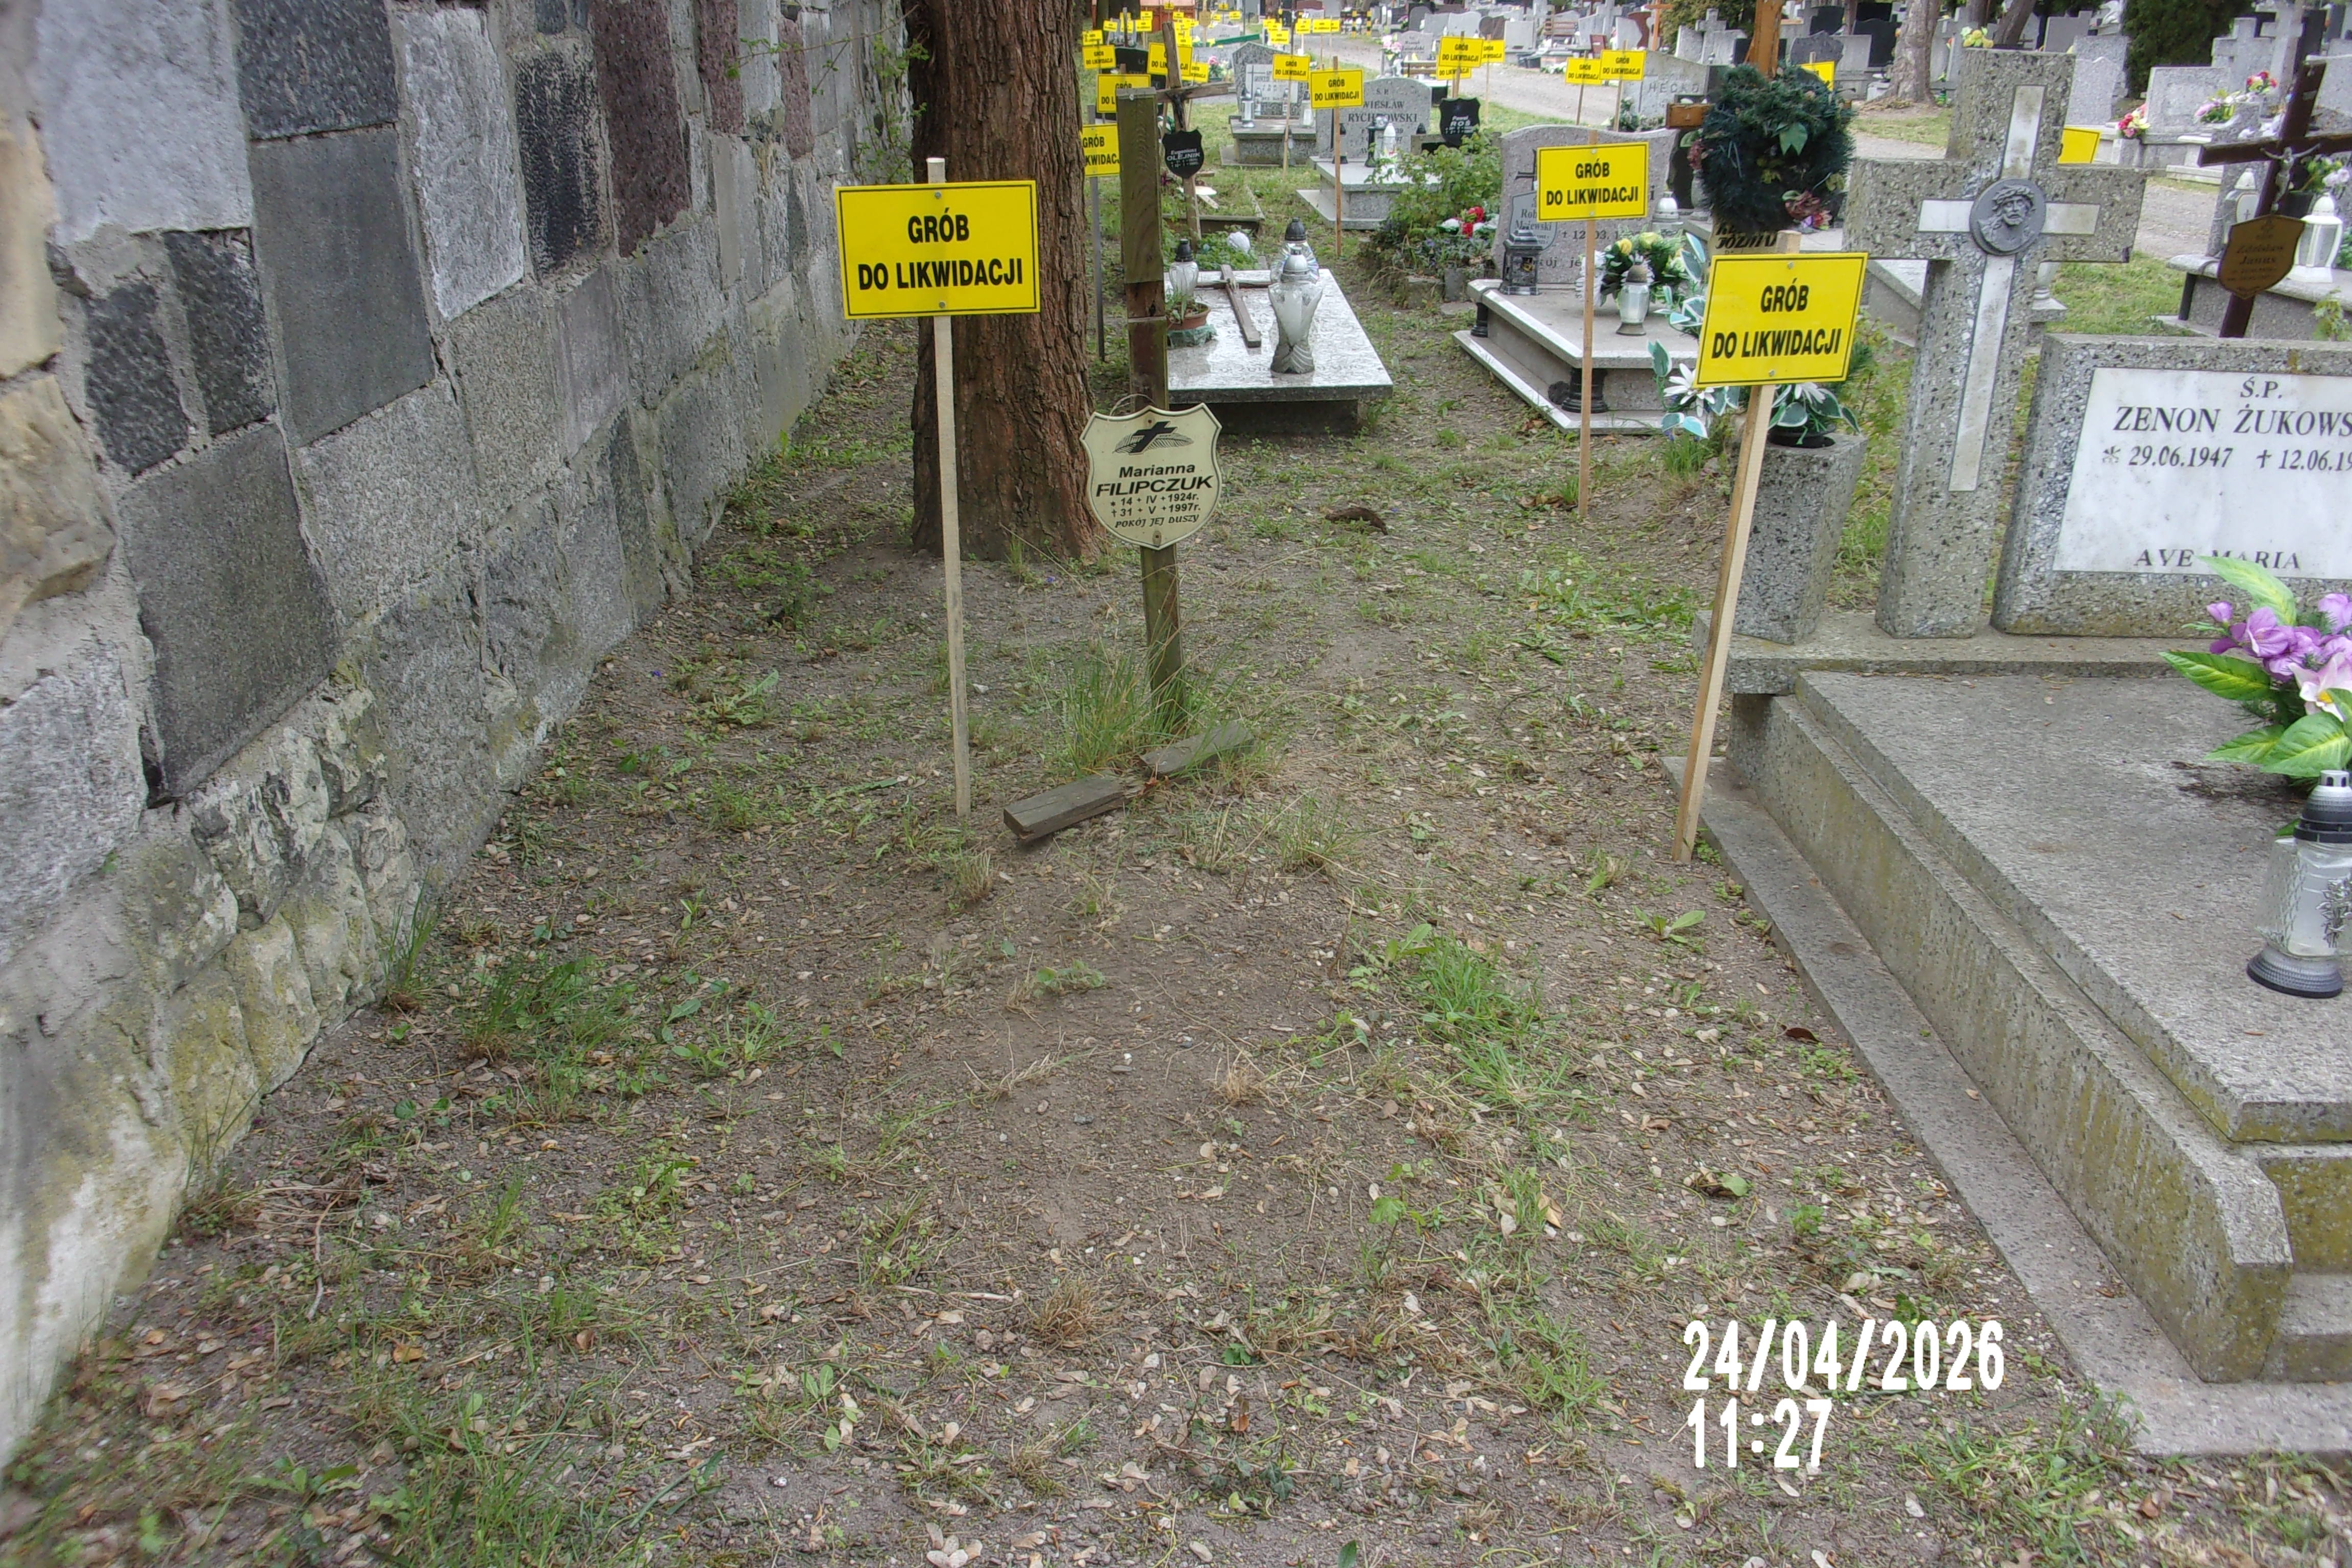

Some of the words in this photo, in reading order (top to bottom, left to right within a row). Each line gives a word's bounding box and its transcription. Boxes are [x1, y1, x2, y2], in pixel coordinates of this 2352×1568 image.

[1328, 78, 1345, 87] GRÓB
[1101, 96, 1110, 105] DO
[1325, 91, 1359, 101] LIKWIDACJI
[1083, 134, 1105, 148] GRÓB
[1167, 152, 1200, 161] OLEJNIK
[1576, 158, 1610, 179] GRÓB
[1546, 190, 1563, 206] DO
[1567, 186, 1638, 205] LIKWIDACJI
[908, 208, 970, 243] GRÓB
[858, 263, 889, 290] DO
[897, 258, 1023, 289] LIKWIDACJI
[1761, 278, 1809, 313] GRÓB
[1711, 332, 1737, 359] DO
[1741, 328, 1842, 358] LIKWIDACJI
[2240, 376, 2282, 399] Ś.P.
[2113, 406, 2221, 432] ZENON
[2128, 445, 2234, 468] 29.06.1947
[1119, 464, 1195, 478] Marianna
[1096, 475, 1214, 497] FILIPCZUK
[1120, 497, 1133, 506] 14
[1146, 495, 1157, 504] IV
[1168, 492, 1199, 502] 1924r.
[1148, 506, 1156, 514] V
[1168, 503, 1200, 513] 1997r.
[1115, 517, 1146, 528] POKÓJ
[1149, 517, 1164, 527] JEJ
[1168, 514, 1199, 524] DUSZY
[2134, 548, 2195, 567] AVE
